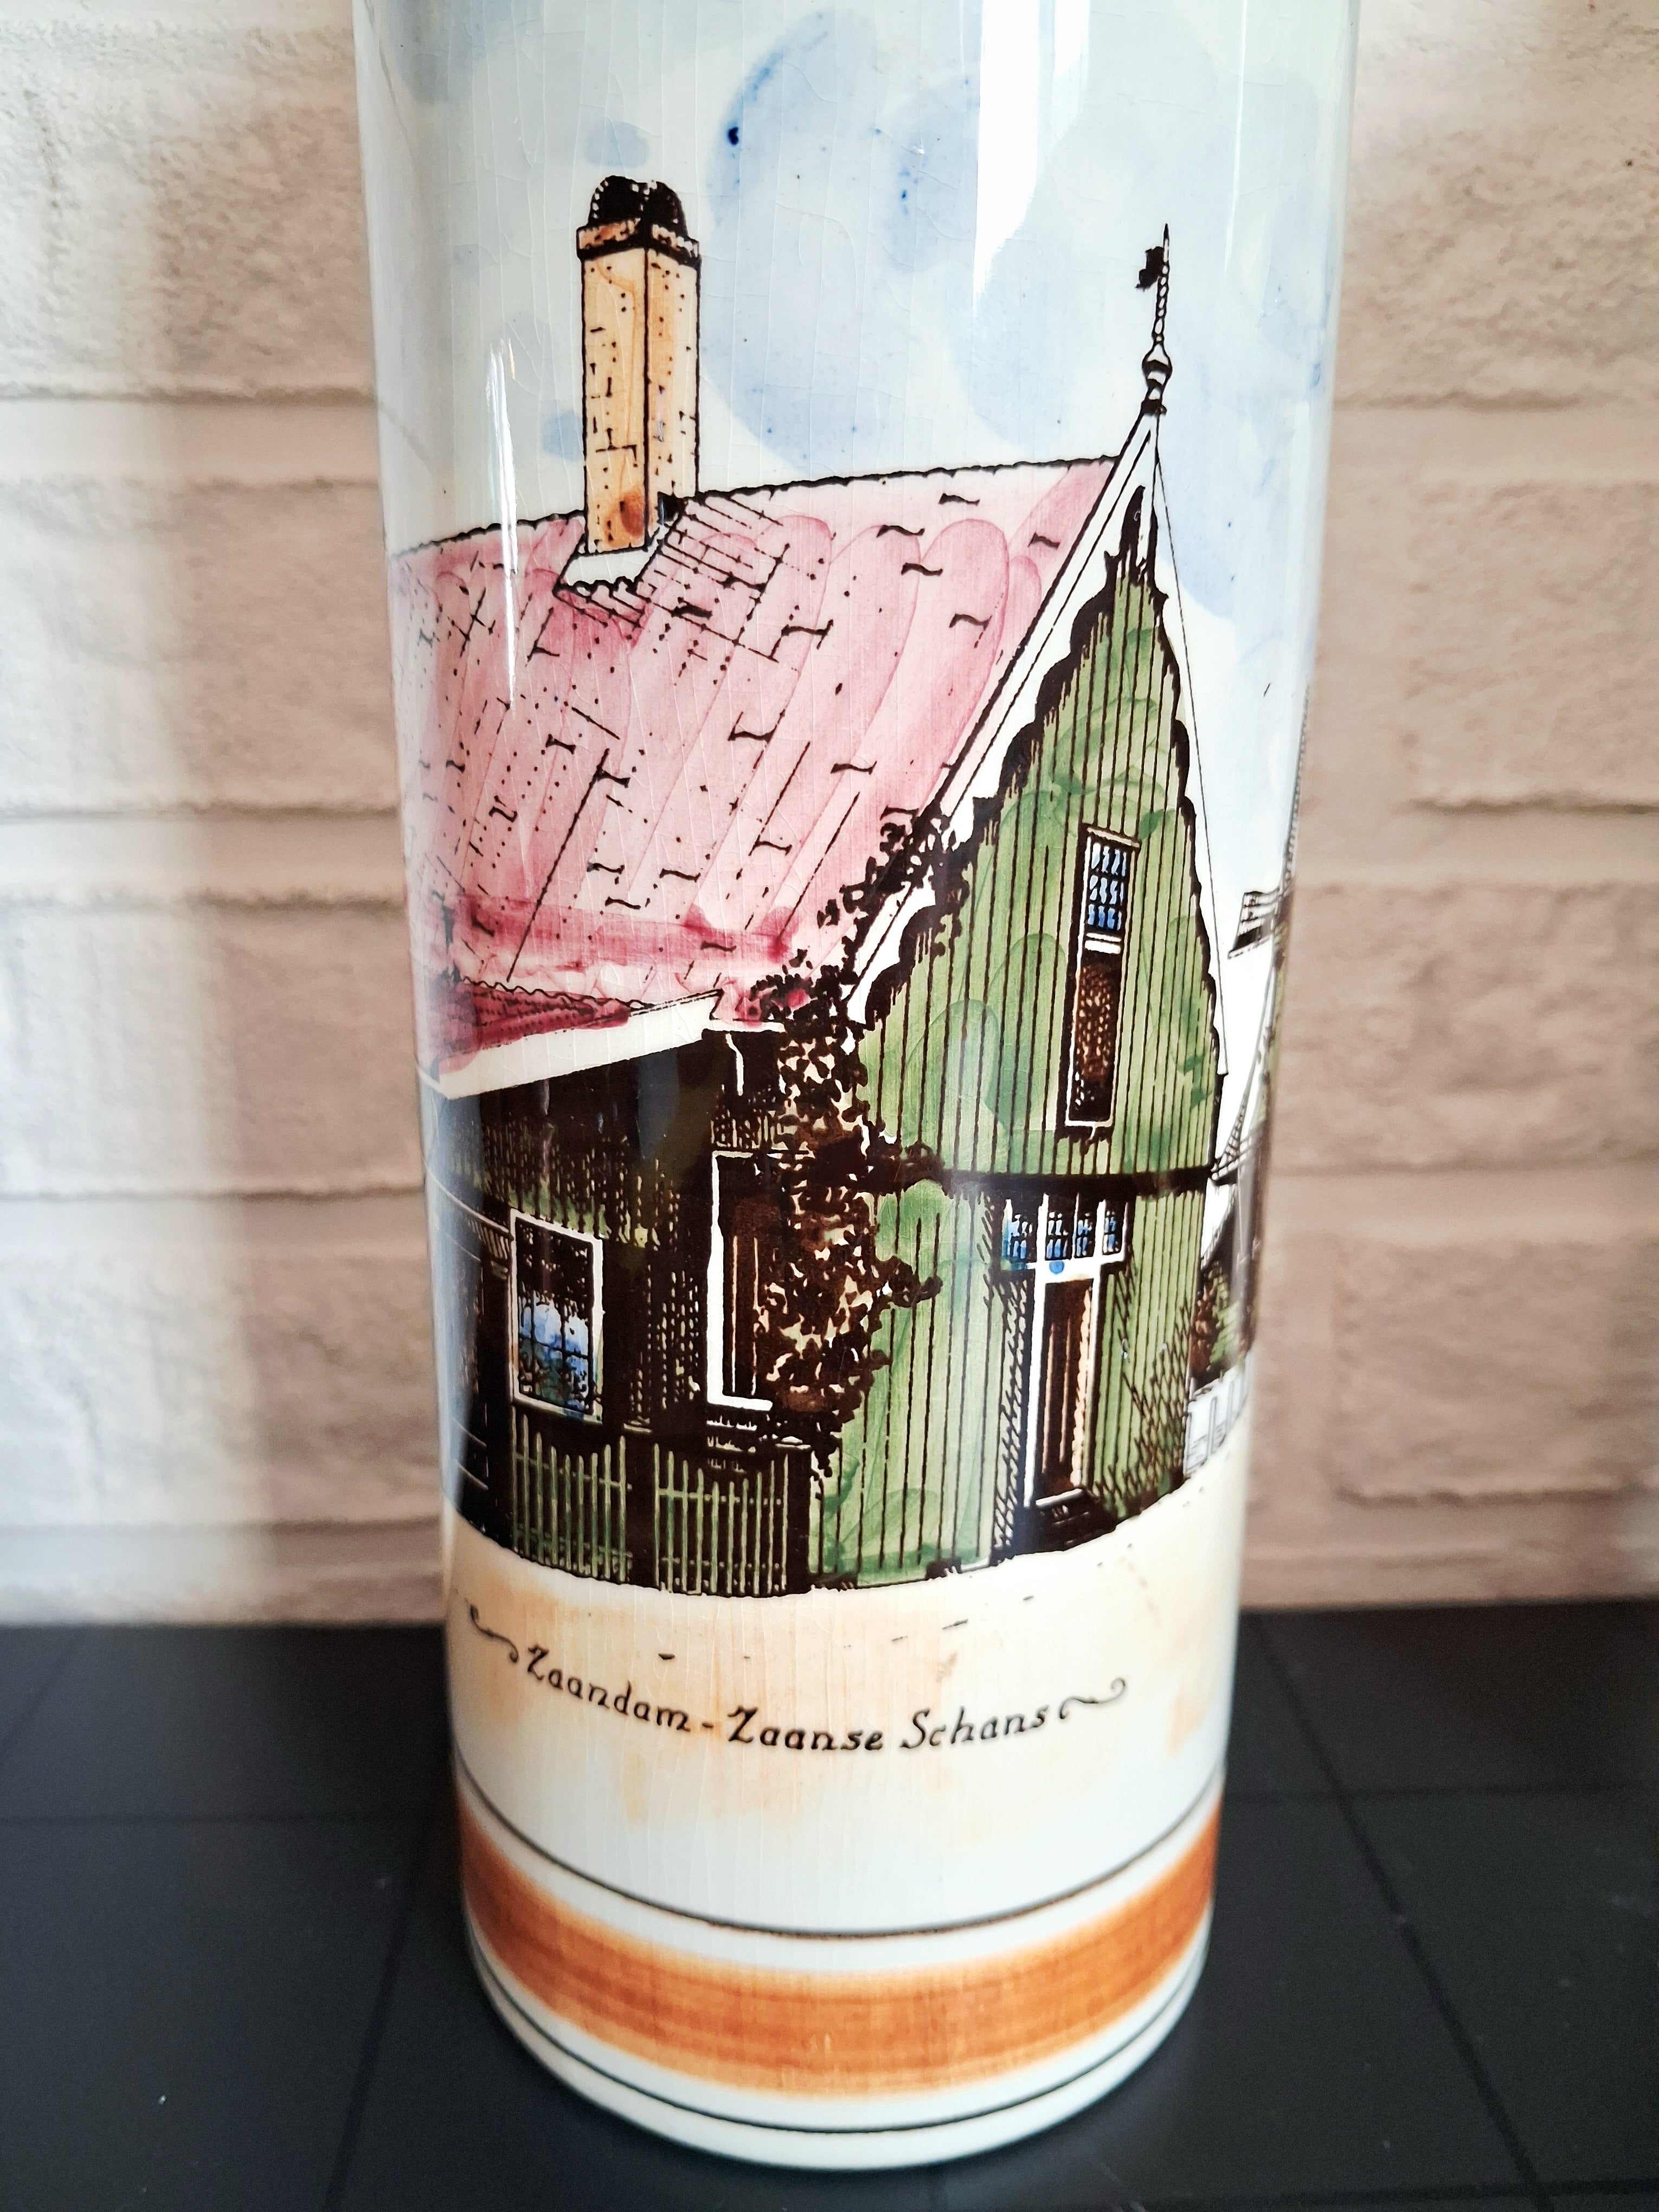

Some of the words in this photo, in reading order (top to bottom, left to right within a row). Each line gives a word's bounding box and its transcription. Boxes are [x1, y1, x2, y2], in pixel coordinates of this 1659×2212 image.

[527, 1644, 691, 1733] Zaandam
[728, 1706, 884, 1751] Zaanse
[900, 1706, 1050, 1750] Schans
